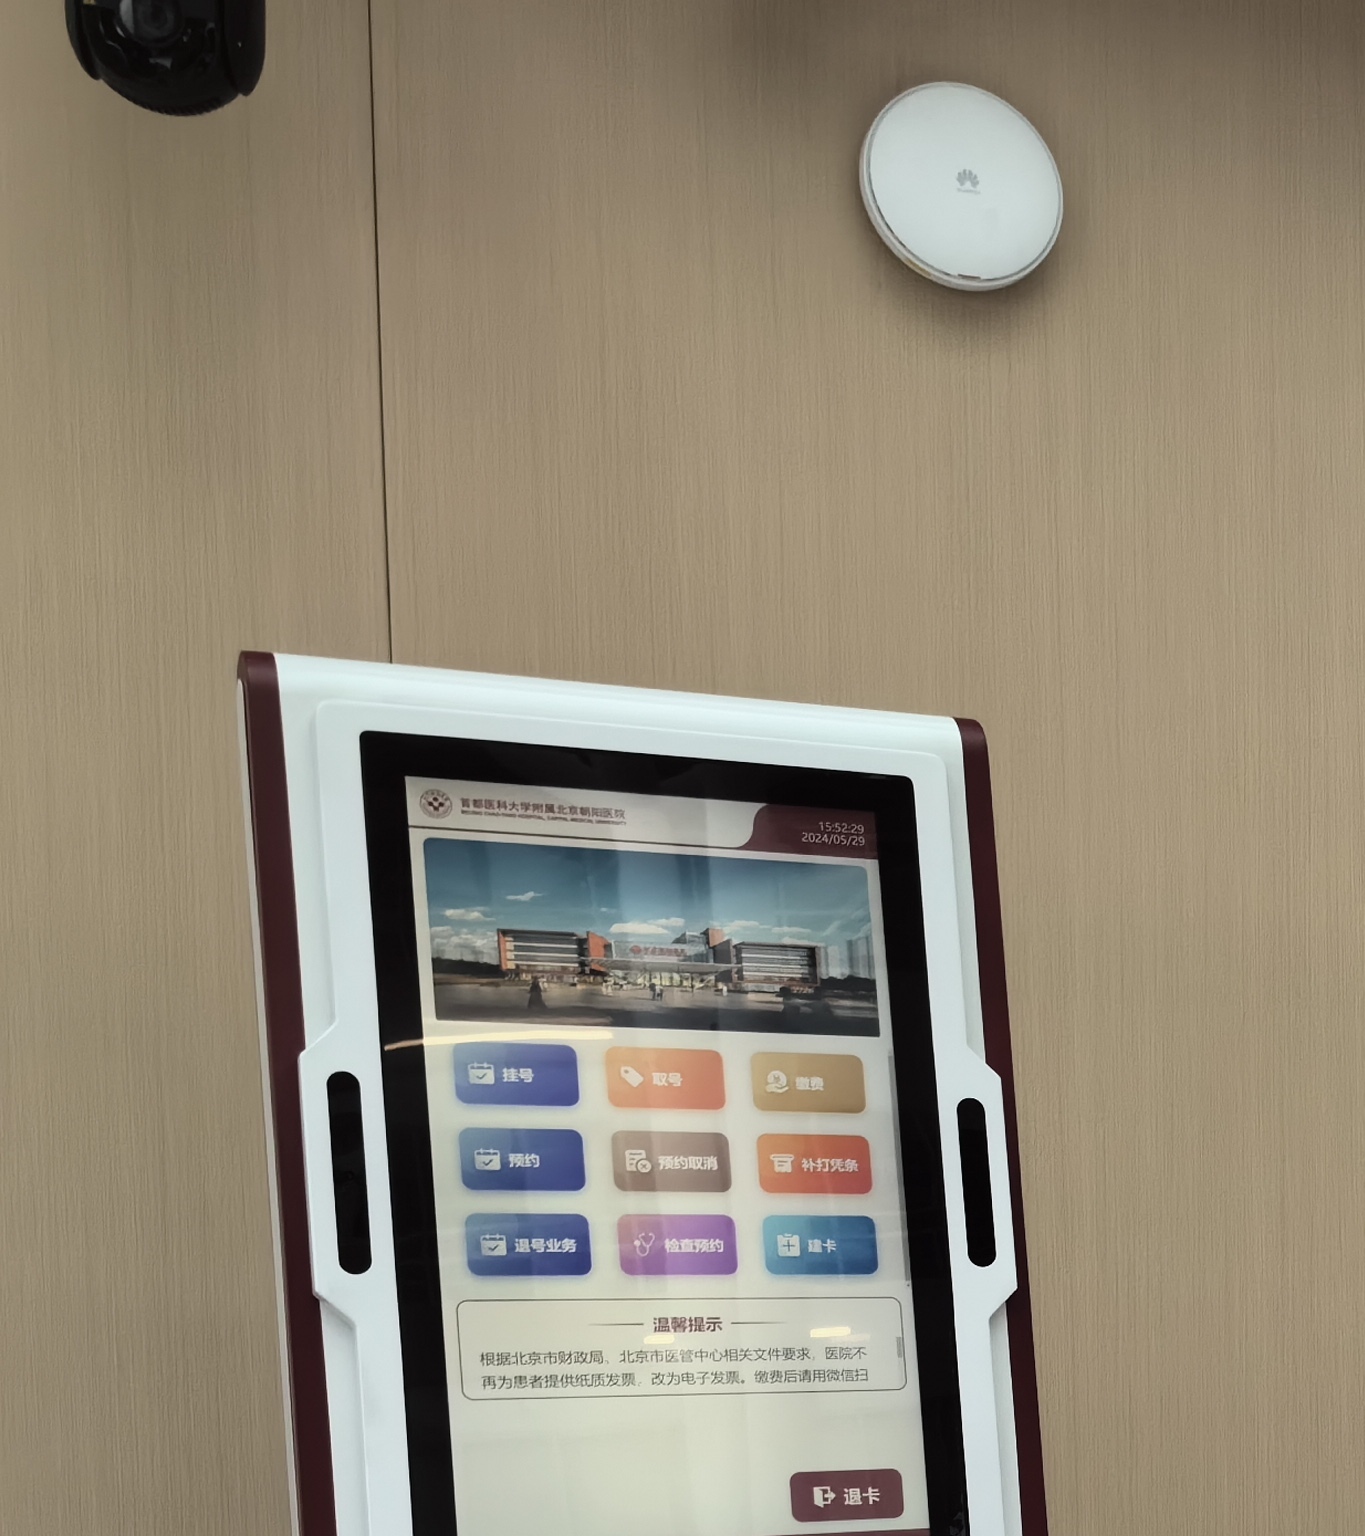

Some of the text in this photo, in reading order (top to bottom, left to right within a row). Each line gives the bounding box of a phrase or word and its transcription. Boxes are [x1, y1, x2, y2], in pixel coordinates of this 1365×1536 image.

[819, 822, 865, 834] 15:52:29
[801, 832, 866, 846] 2024/05/29
[502, 1067, 534, 1083] 挂号
[652, 1072, 683, 1088] 取号
[508, 1153, 540, 1168] 预约
[658, 1155, 719, 1171] 预约取消
[801, 1157, 859, 1173] 补打凭条
[515, 1238, 577, 1254] 退号业务
[664, 1237, 724, 1254] 检查预约
[653, 1316, 723, 1333] 温馨提示
[843, 1486, 881, 1506] 退卡
